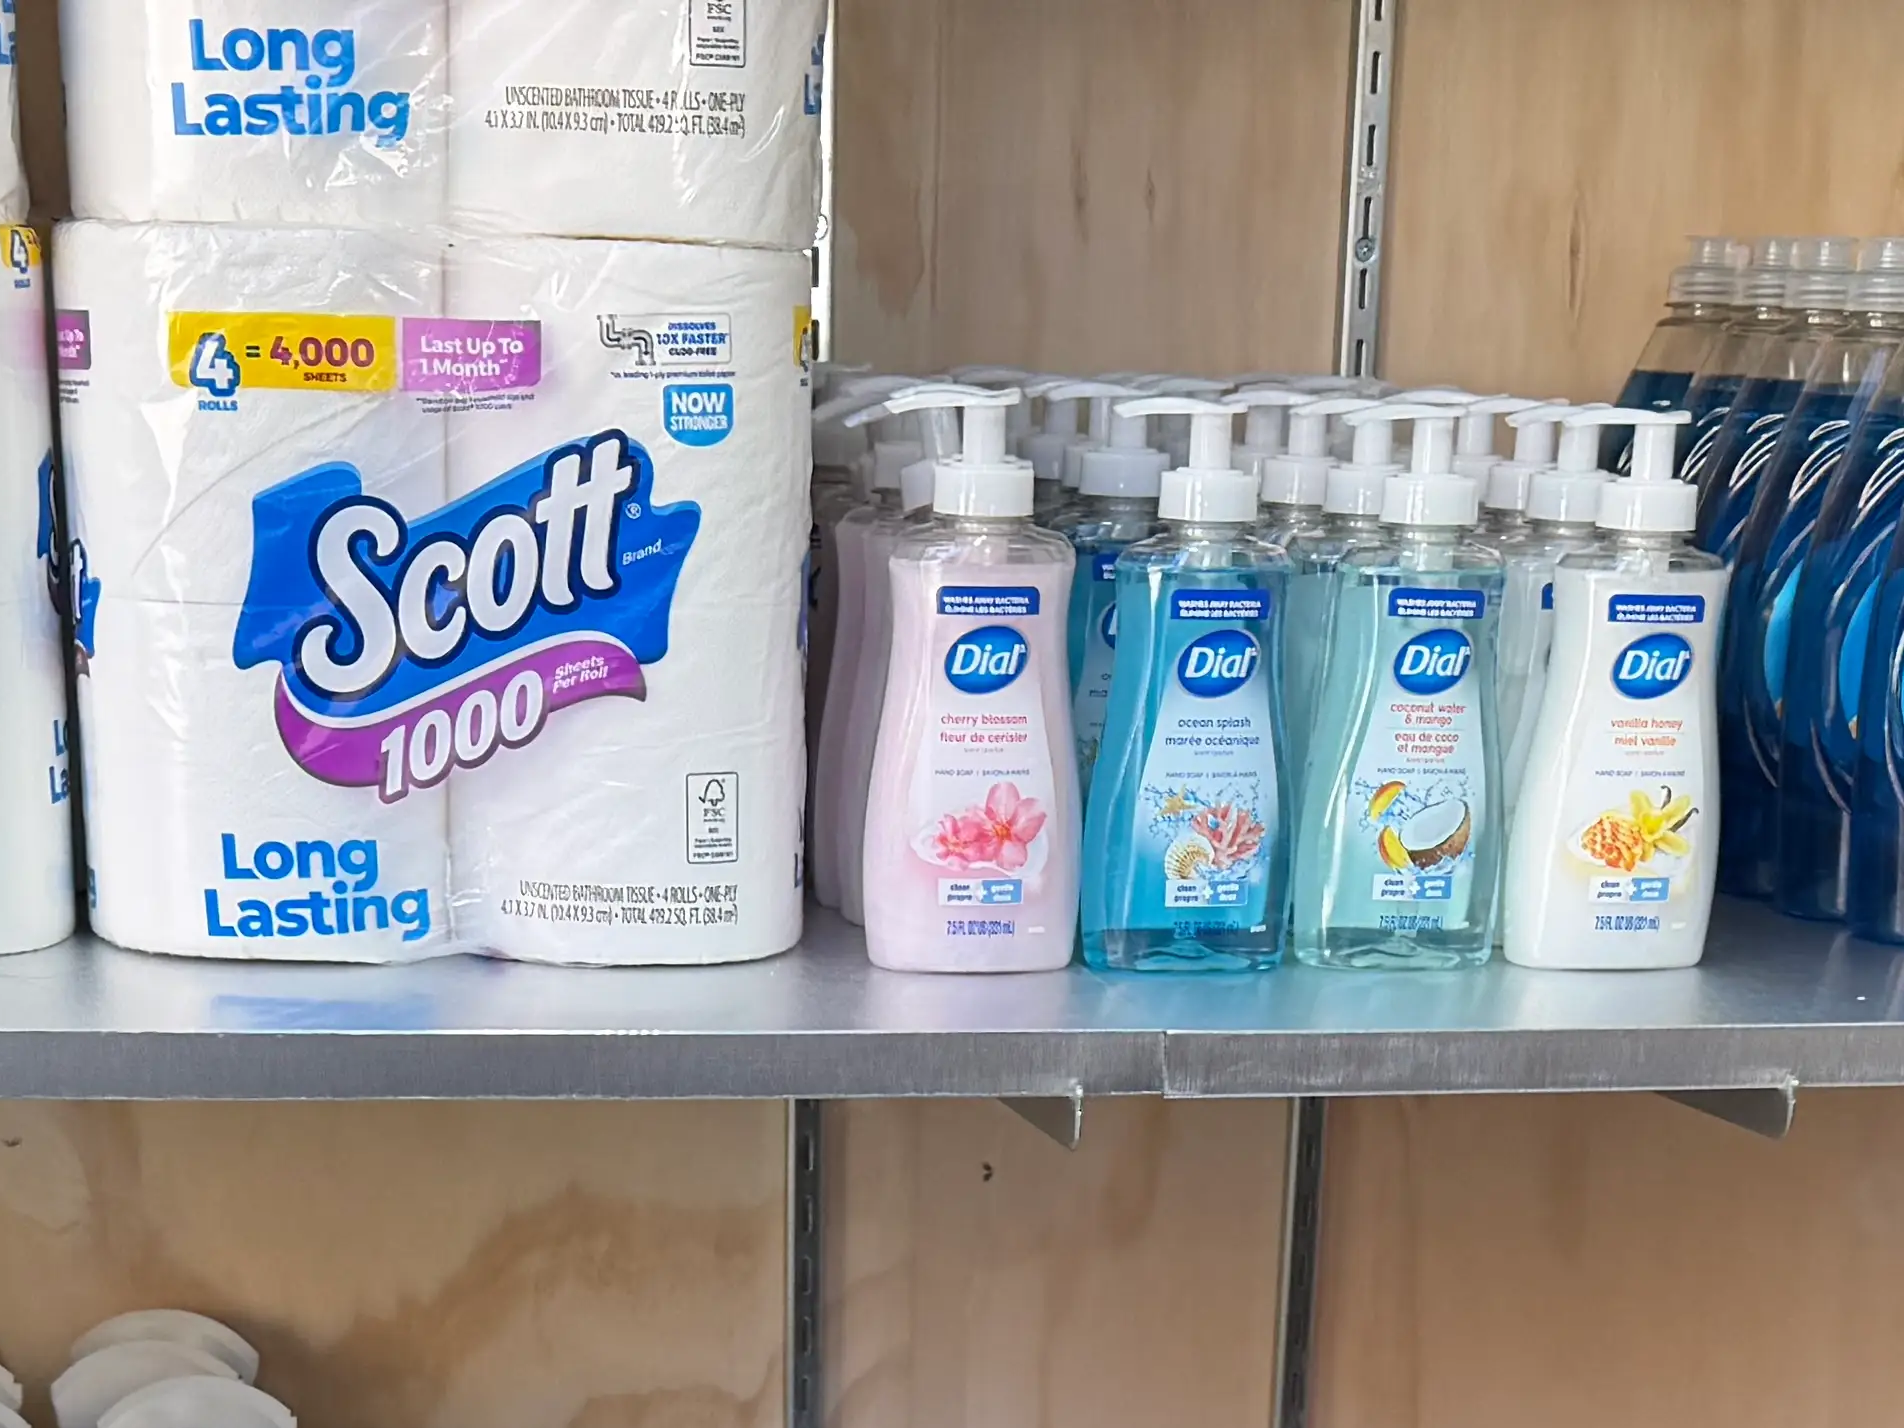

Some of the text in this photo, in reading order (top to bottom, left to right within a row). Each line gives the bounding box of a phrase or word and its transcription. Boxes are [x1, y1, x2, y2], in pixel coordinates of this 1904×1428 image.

[190, 18, 355, 87] Long
[172, 75, 410, 147] Lasting
[420, 335, 523, 360] Last Up To
[193, 335, 375, 394] 4 4,000
[304, 372, 346, 382] SHEETS
[198, 400, 238, 411] ROLLS
[672, 394, 724, 415] NOW
[671, 416, 727, 432] STRONGER
[301, 438, 632, 692] Scott
[622, 539, 662, 566] Brand
[554, 655, 604, 680] Sheets
[951, 643, 1025, 676] Dial
[1184, 647, 1256, 679] Dial
[1400, 645, 1469, 676] Dial
[1618, 650, 1689, 681] Dial
[553, 665, 608, 693] Per Roll
[941, 713, 1027, 728] cherry blossom
[1391, 703, 1466, 714] coconut water
[380, 671, 543, 795] 1000
[1178, 716, 1251, 731] ocean splash
[1415, 716, 1452, 727] mango
[1610, 718, 1683, 731] vanilla honey
[940, 732, 1028, 743] fleur de cerisier
[1165, 734, 1260, 749] marée océanique
[1394, 732, 1459, 744] eau de coco
[1398, 743, 1454, 757] et mangue
[1614, 735, 1676, 747] miel vanille
[221, 832, 378, 892] Long
[204, 882, 431, 942] Lasting
